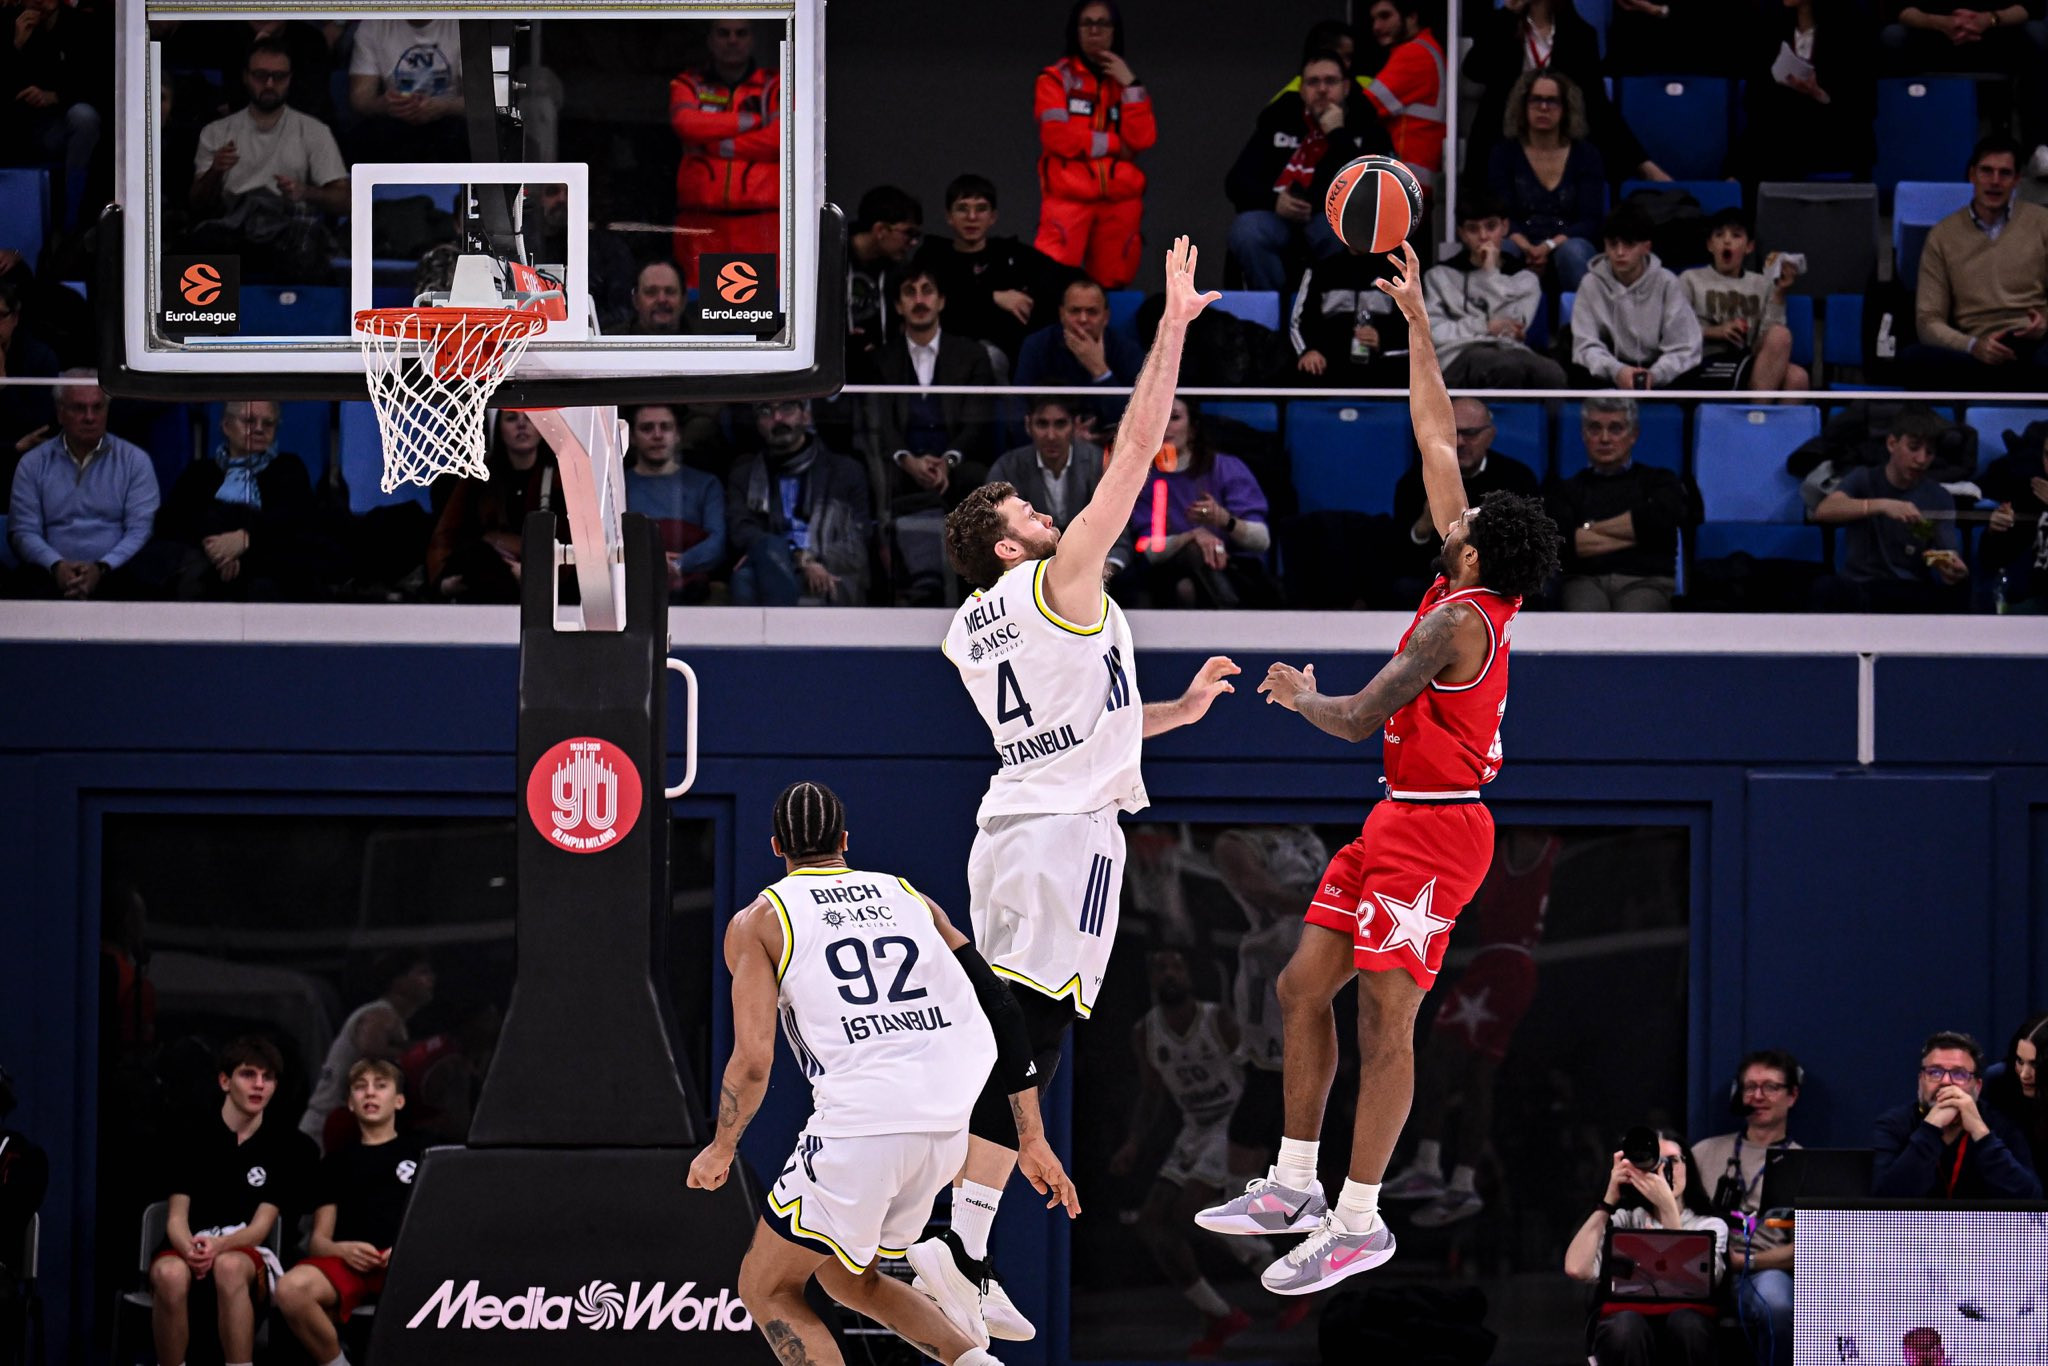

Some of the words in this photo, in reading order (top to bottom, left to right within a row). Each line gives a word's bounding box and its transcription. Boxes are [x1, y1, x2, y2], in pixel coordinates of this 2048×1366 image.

[165, 310, 237, 325] EuroLeague
[701, 308, 774, 323] EuroLeague
[964, 596, 1007, 636] MELLI
[982, 622, 1021, 653] MSC
[997, 659, 1035, 728] 4
[552, 755, 618, 831] 90
[551, 826, 585, 849] OLIMPIA
[585, 827, 617, 849] MILANO
[809, 883, 883, 905] BIRCH
[1324, 883, 1343, 896] EA7
[845, 905, 893, 922] MSC
[825, 935, 929, 1006] 92
[405, 1279, 573, 1330] Media
